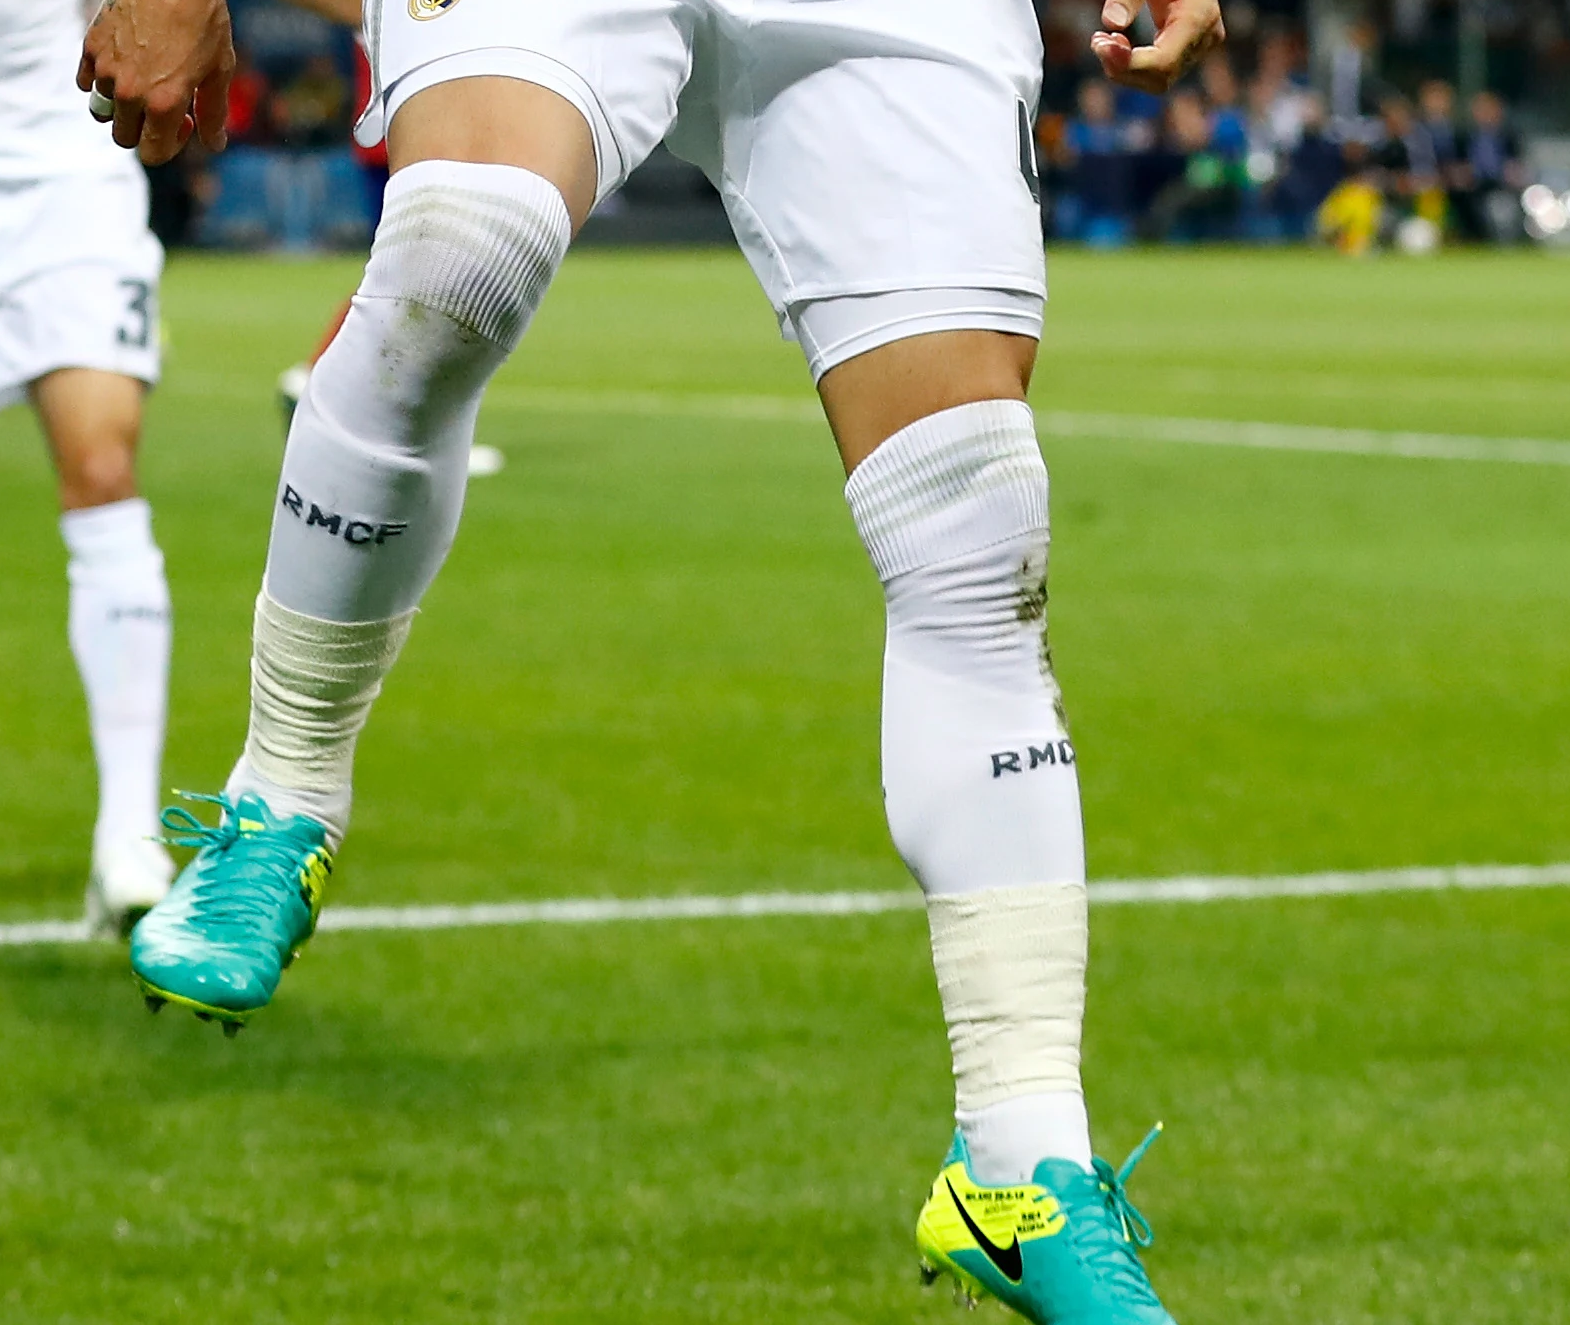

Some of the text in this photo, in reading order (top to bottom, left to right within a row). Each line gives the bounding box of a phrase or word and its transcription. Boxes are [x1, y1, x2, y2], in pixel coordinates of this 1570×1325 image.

[115, 277, 151, 350] 3
[282, 482, 408, 545] RMCF
[990, 739, 1076, 778] RMC
